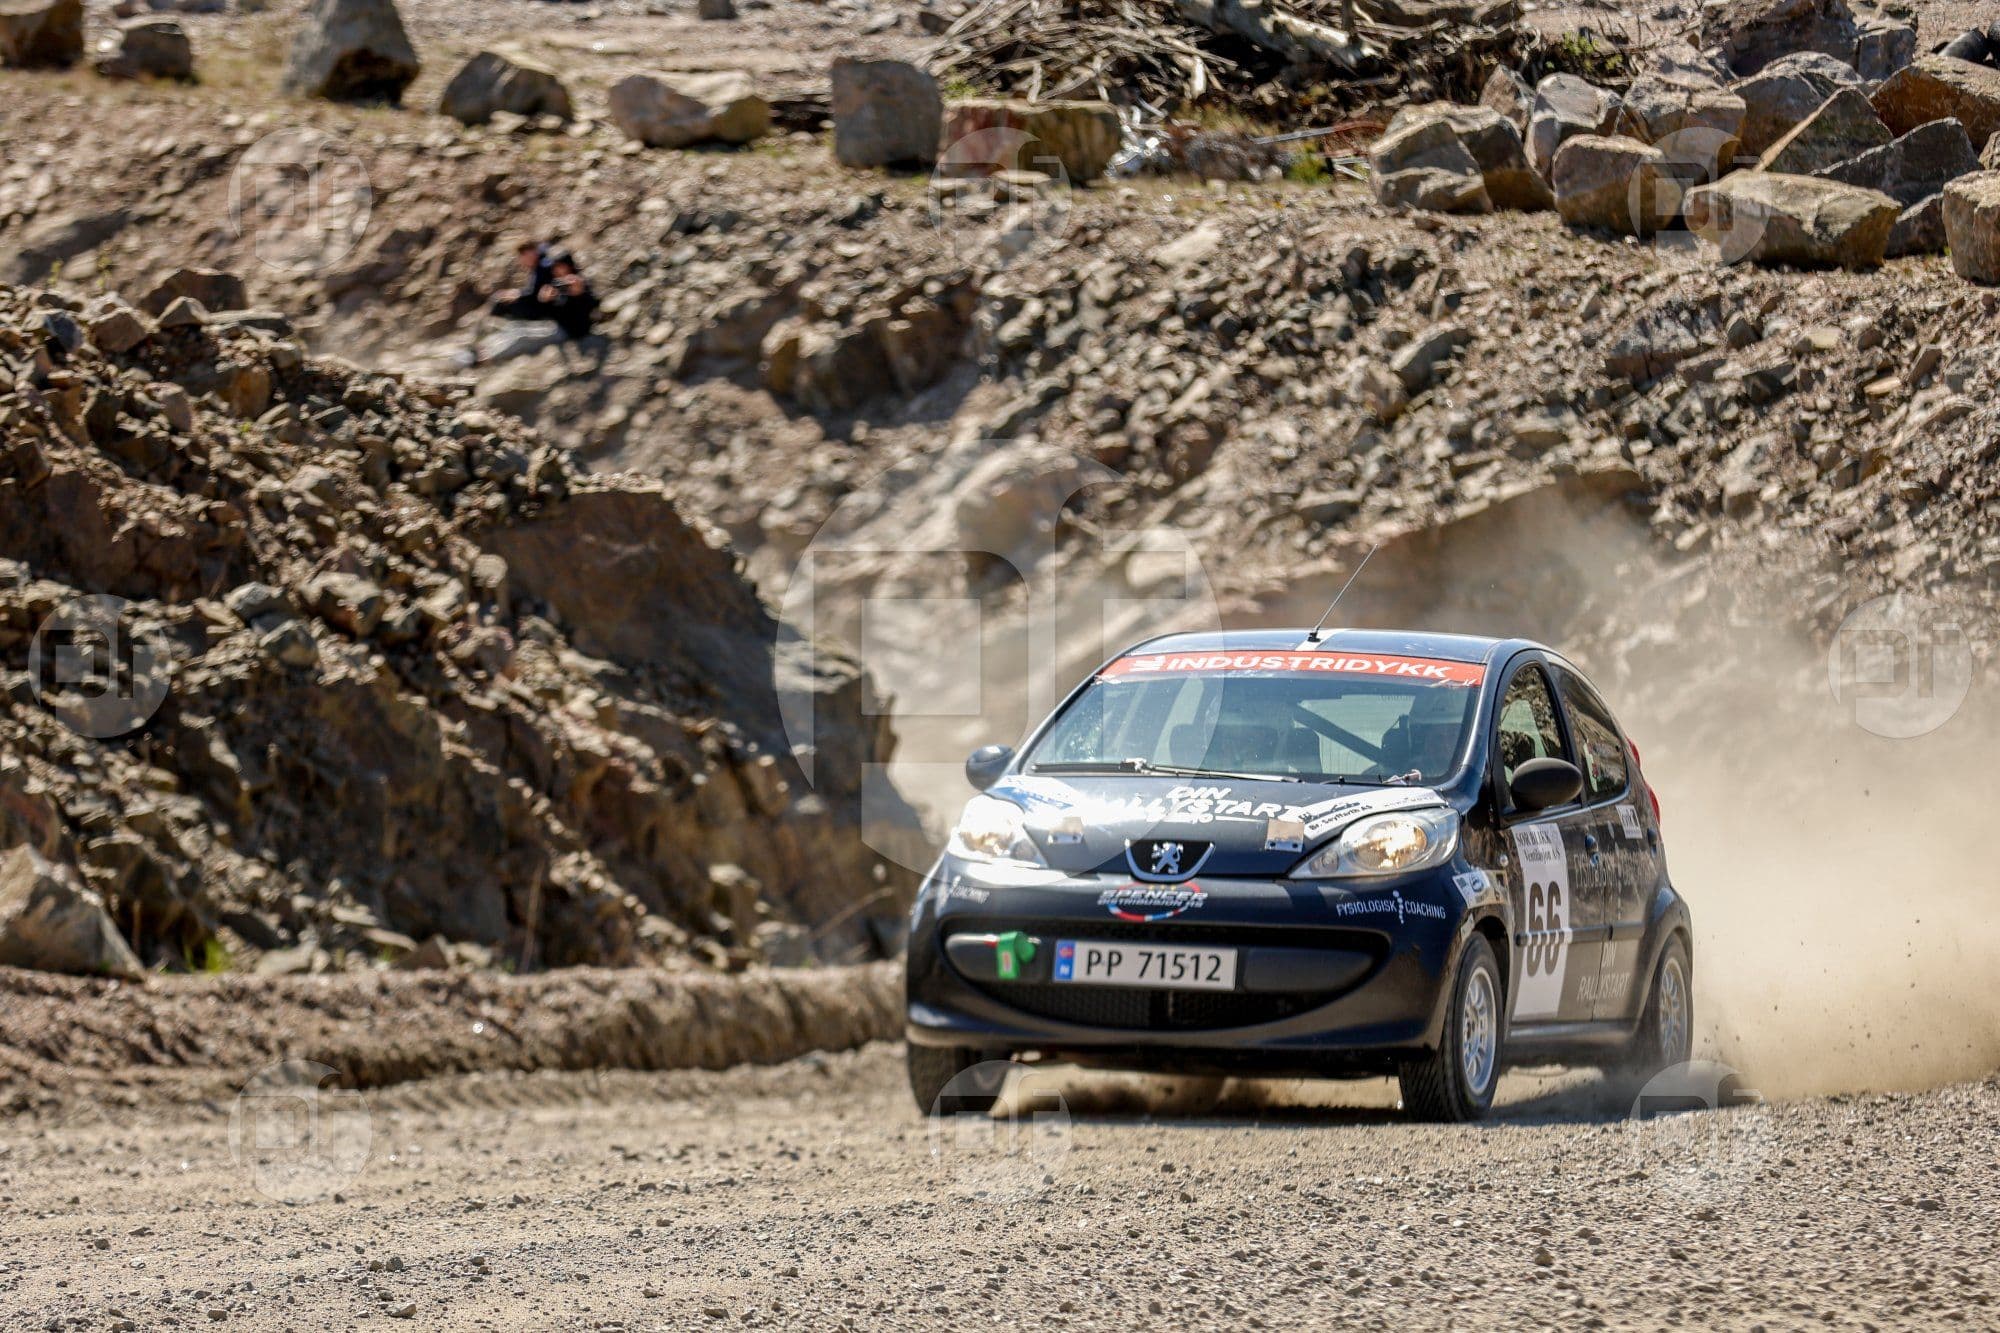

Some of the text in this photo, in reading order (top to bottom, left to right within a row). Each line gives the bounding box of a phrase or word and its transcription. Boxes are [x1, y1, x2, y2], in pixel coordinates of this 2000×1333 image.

[1167, 655, 1453, 678] INDUSTRIDYKK
[1166, 786, 1232, 799] DIN
[1102, 889, 1208, 902] SPENCER
[1336, 900, 1446, 919] FYSIOLOGISK COACHING
[1526, 881, 1562, 977] 66
[1086, 949, 1221, 982] PP 71512
